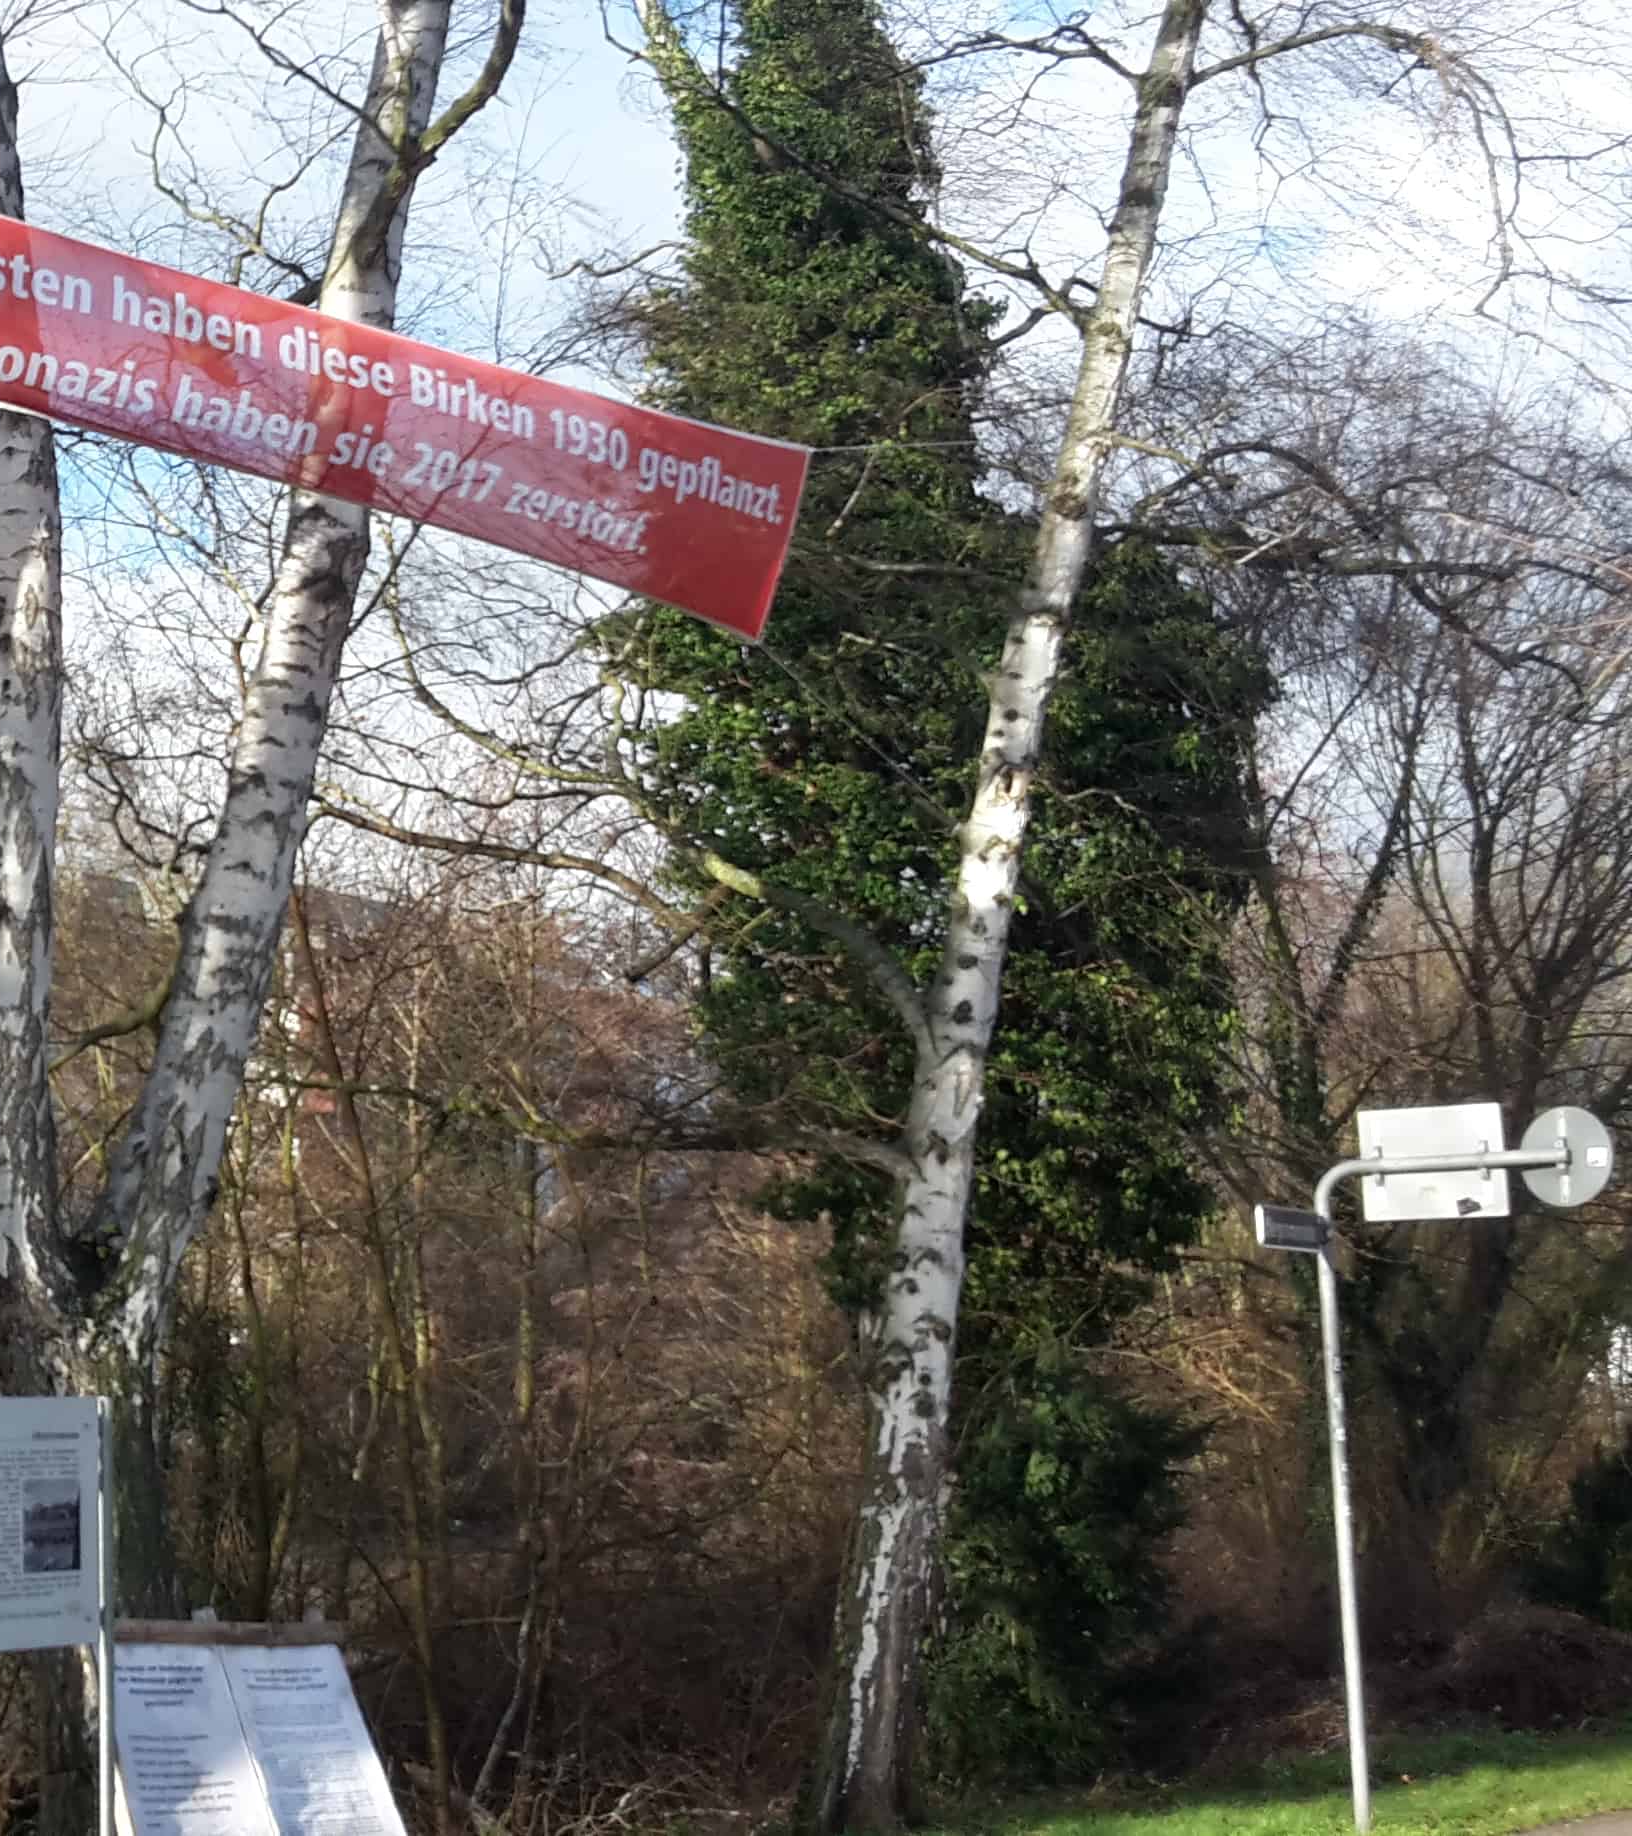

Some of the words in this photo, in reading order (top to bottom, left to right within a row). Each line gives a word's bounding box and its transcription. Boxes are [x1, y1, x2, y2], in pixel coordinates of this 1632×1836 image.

[113, 275, 262, 358] haben
[278, 326, 396, 397] diese
[409, 363, 536, 439] Birken
[550, 409, 627, 472] 1930
[639, 446, 784, 525] gepflanzt.
[172, 374, 317, 455] haben
[329, 425, 393, 477] sie
[401, 442, 502, 501] 2017
[504, 481, 649, 555] zerstört.
